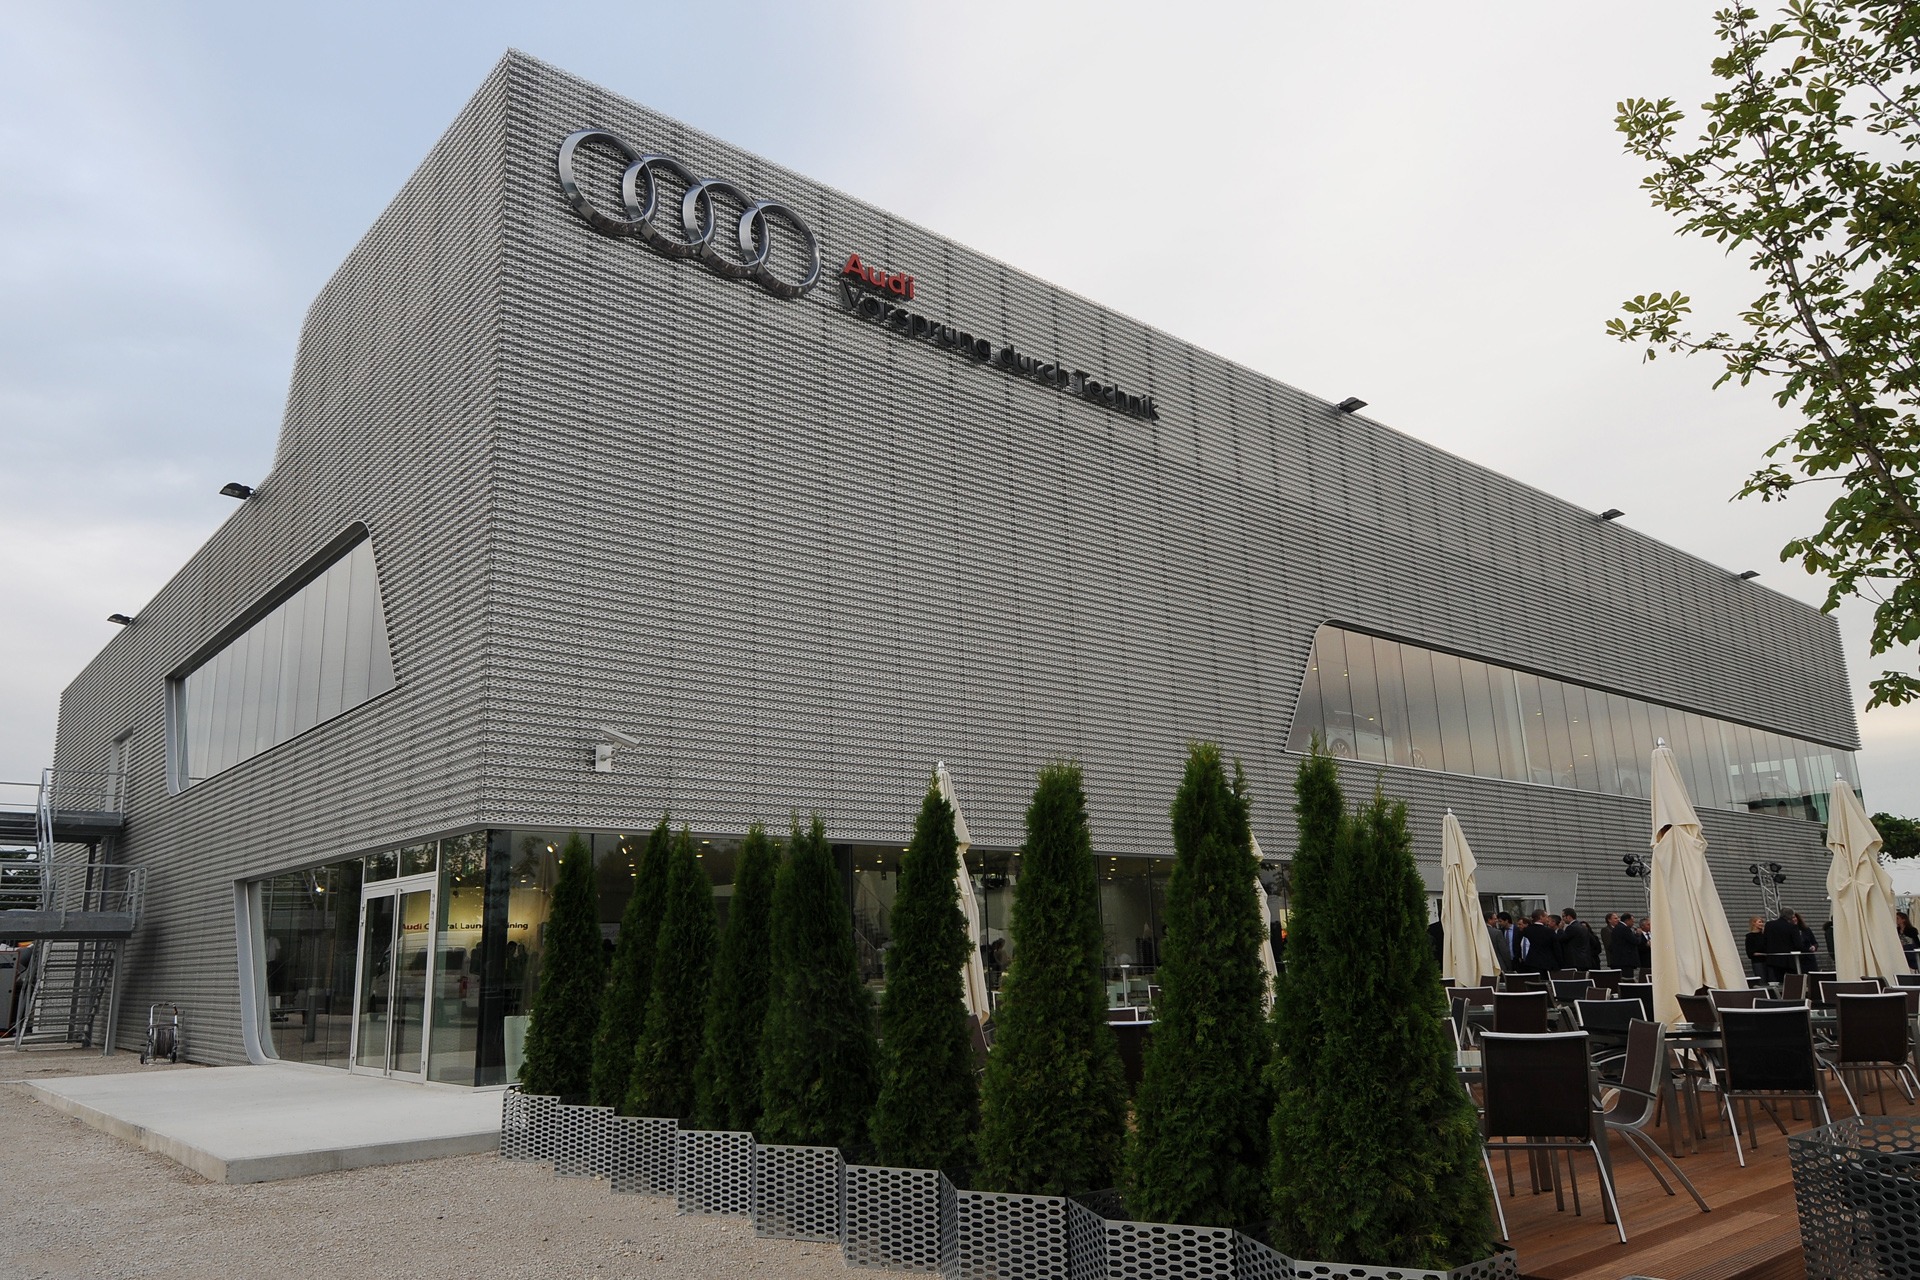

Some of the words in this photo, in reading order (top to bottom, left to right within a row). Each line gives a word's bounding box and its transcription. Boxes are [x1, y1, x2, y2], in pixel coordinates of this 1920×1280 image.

[841, 253, 915, 300] Audi
[840, 279, 991, 362] Vorsprung
[998, 344, 1069, 388] durch
[1074, 368, 1160, 421] Technik
[402, 923, 422, 931] Audi
[424, 922, 458, 930] Cral
[460, 922, 484, 930] Laun
